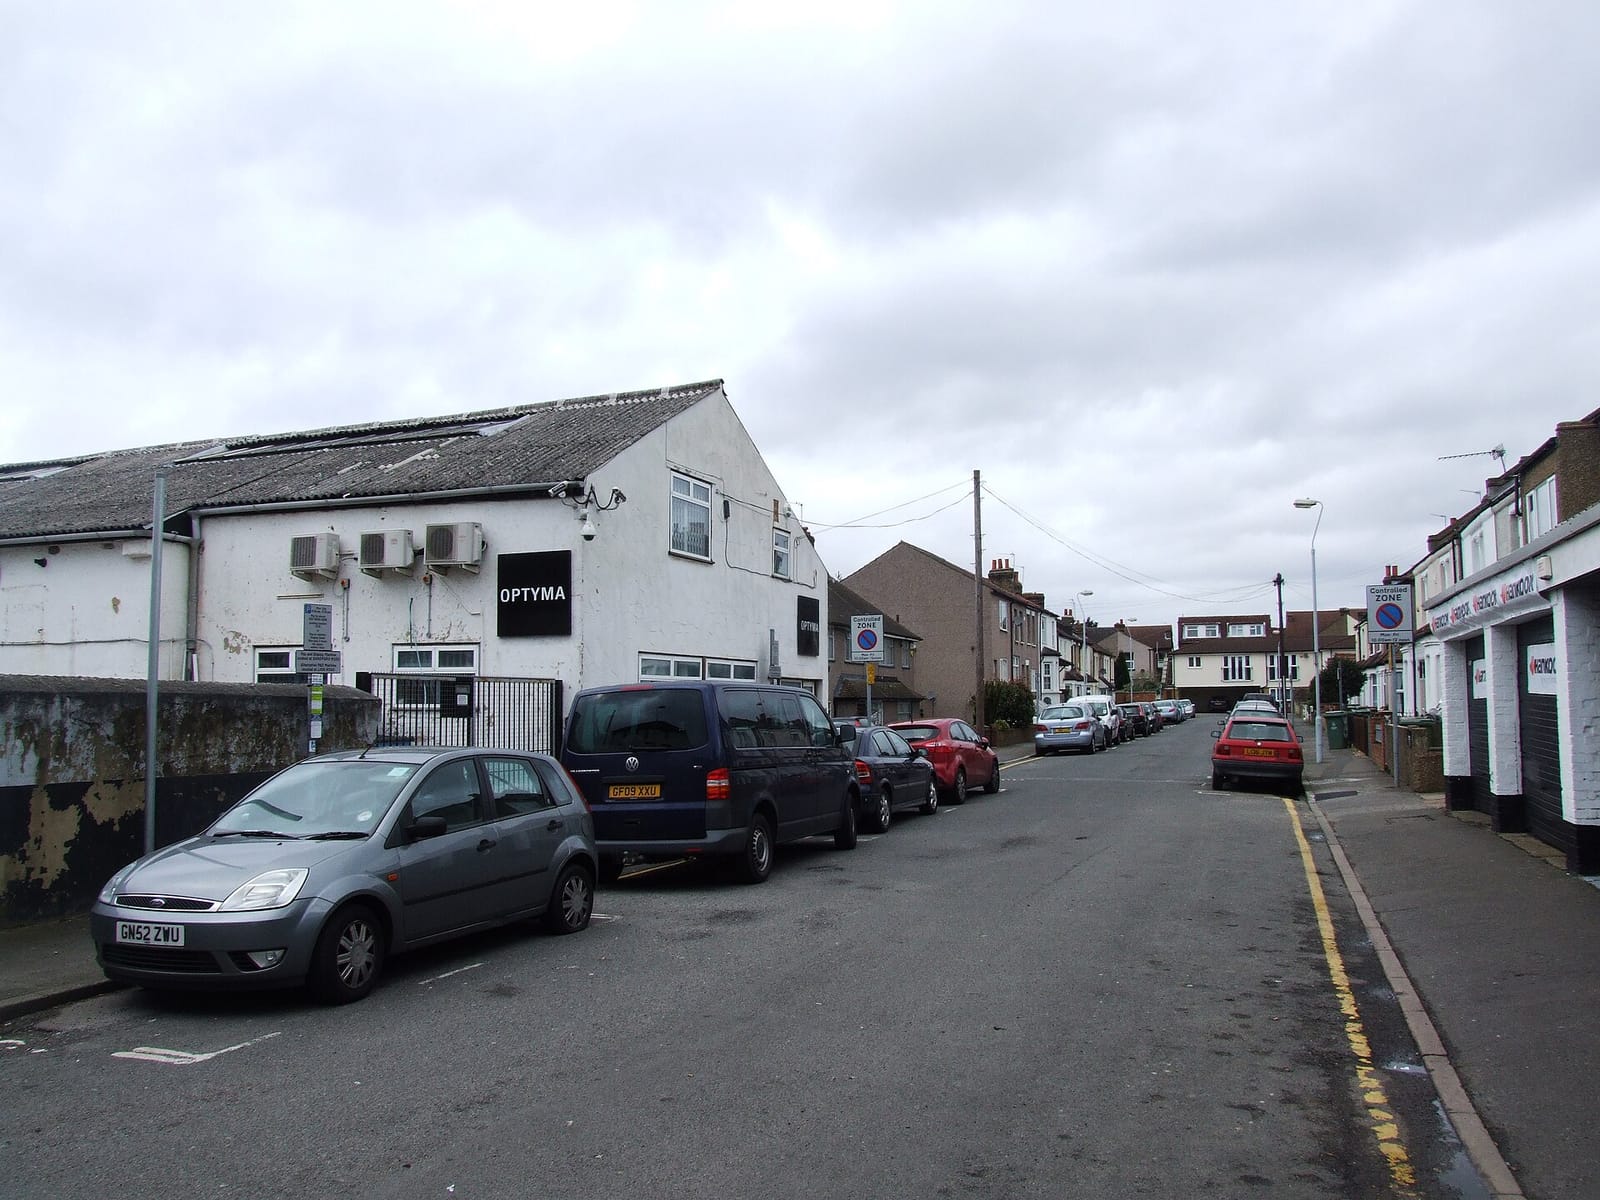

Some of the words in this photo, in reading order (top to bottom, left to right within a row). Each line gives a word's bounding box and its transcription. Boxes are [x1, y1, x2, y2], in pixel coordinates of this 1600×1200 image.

[500, 586, 566, 603] OPTYMA
[1375, 594, 1402, 602] ZONE
[800, 620, 819, 632] OPTYMA
[612, 786, 636, 797] GF09
[638, 785, 657, 796] XXU
[121, 924, 151, 941] GN52
[153, 926, 180, 943] ZWU
